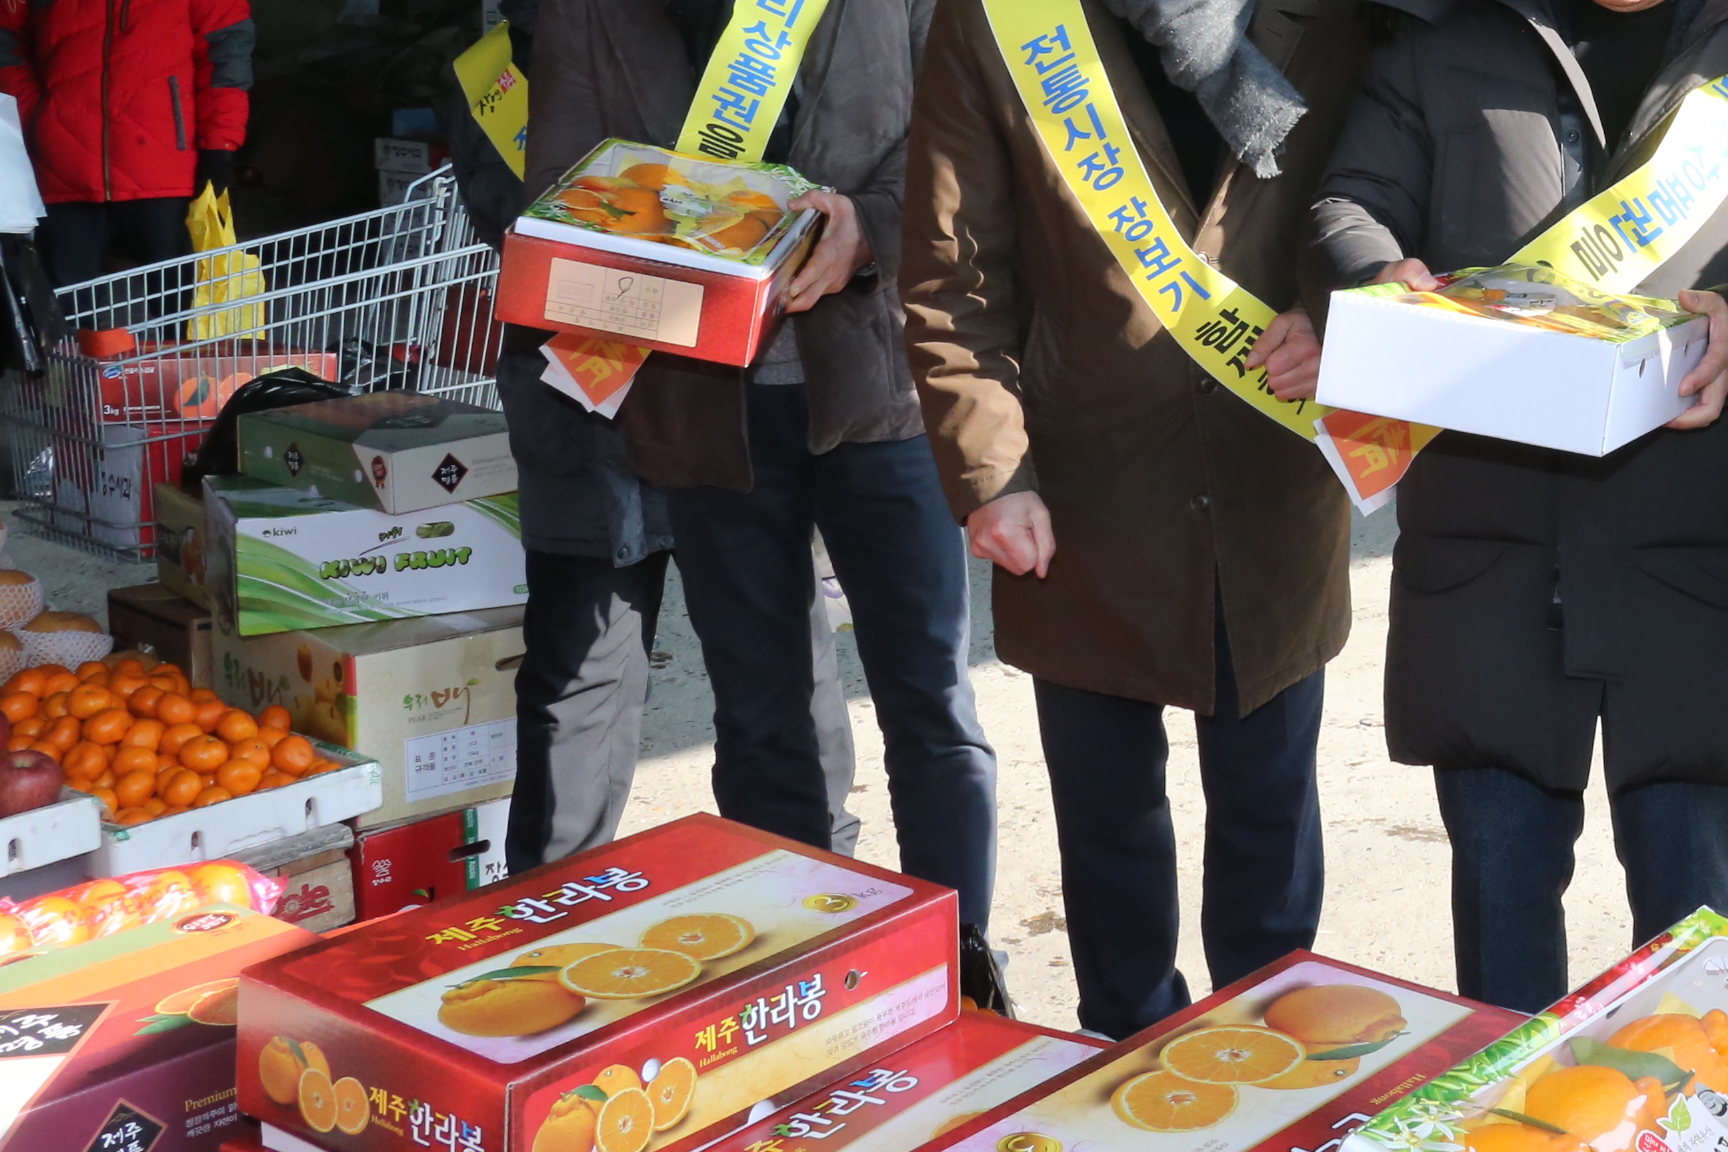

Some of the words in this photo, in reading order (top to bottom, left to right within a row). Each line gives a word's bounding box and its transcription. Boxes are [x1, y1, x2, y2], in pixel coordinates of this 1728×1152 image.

[1020, 24, 1126, 192] 전통시장
[1107, 197, 1211, 313] 장보기
[103, 404, 120, 417] 3kg
[272, 526, 297, 538] kiwi
[319, 555, 387, 580] KIWI
[393, 546, 473, 573] FRUIT
[424, 915, 506, 946] 제주
[493, 866, 650, 925] 한라봉
[457, 926, 524, 952] Hallabong
[694, 1015, 740, 1053] 제주
[738, 972, 827, 1047] 한라봉
[698, 1045, 738, 1068] Hallabong
[184, 1086, 238, 1114] Premium
[772, 1066, 920, 1141] 한라봉
[1369, 1073, 1427, 1106] Hallabong
[101, 1120, 144, 1148] 제주
[369, 1086, 408, 1123] 제주
[407, 1098, 486, 1152] 한라봉
